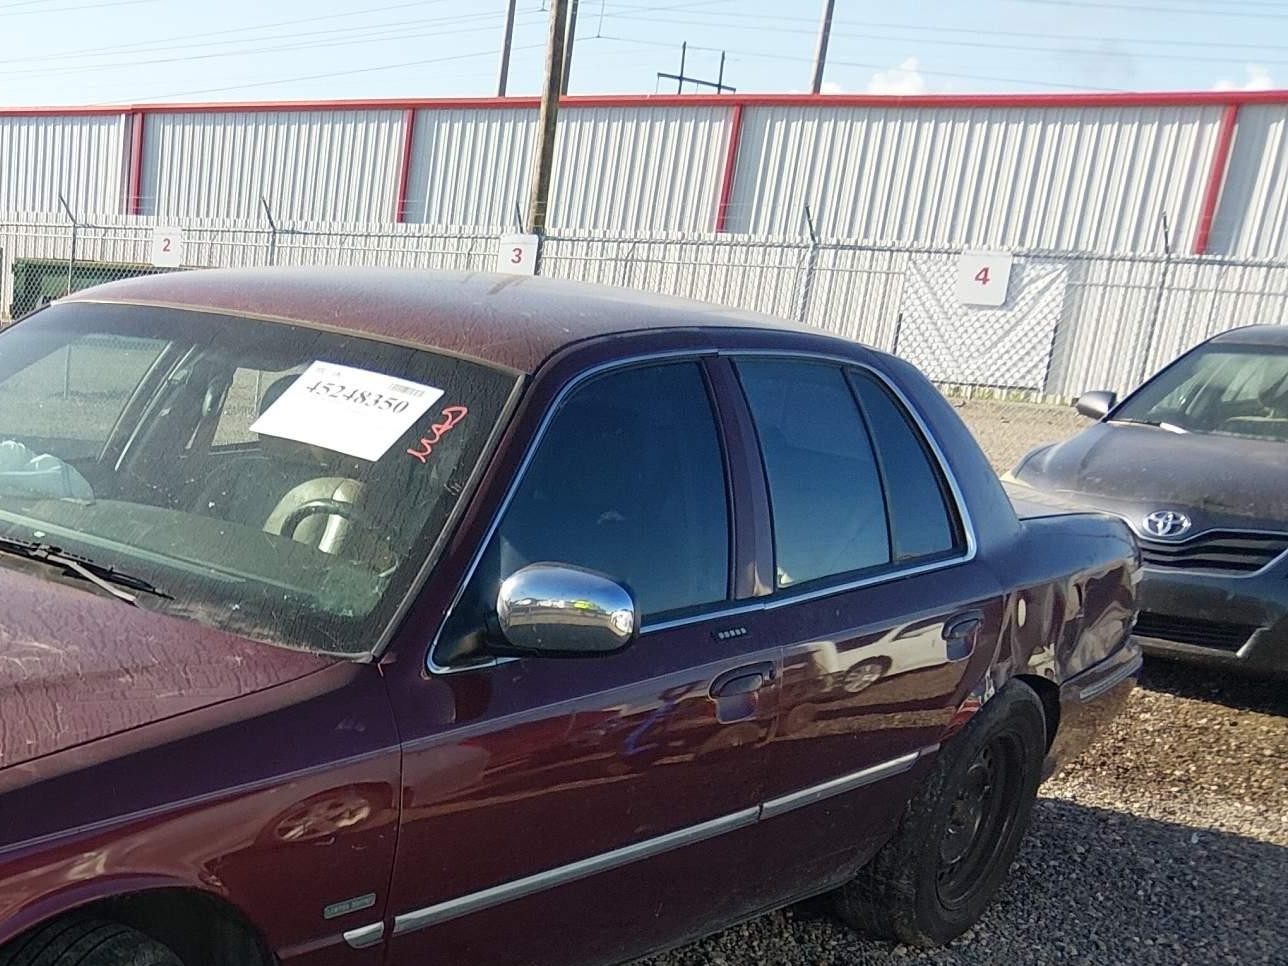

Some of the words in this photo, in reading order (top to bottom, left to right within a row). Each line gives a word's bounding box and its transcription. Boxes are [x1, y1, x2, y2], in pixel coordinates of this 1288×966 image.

[163, 238, 171, 252] 2
[511, 247, 522, 263] 3
[974, 267, 991, 285] 4
[306, 380, 409, 414] 45248350
